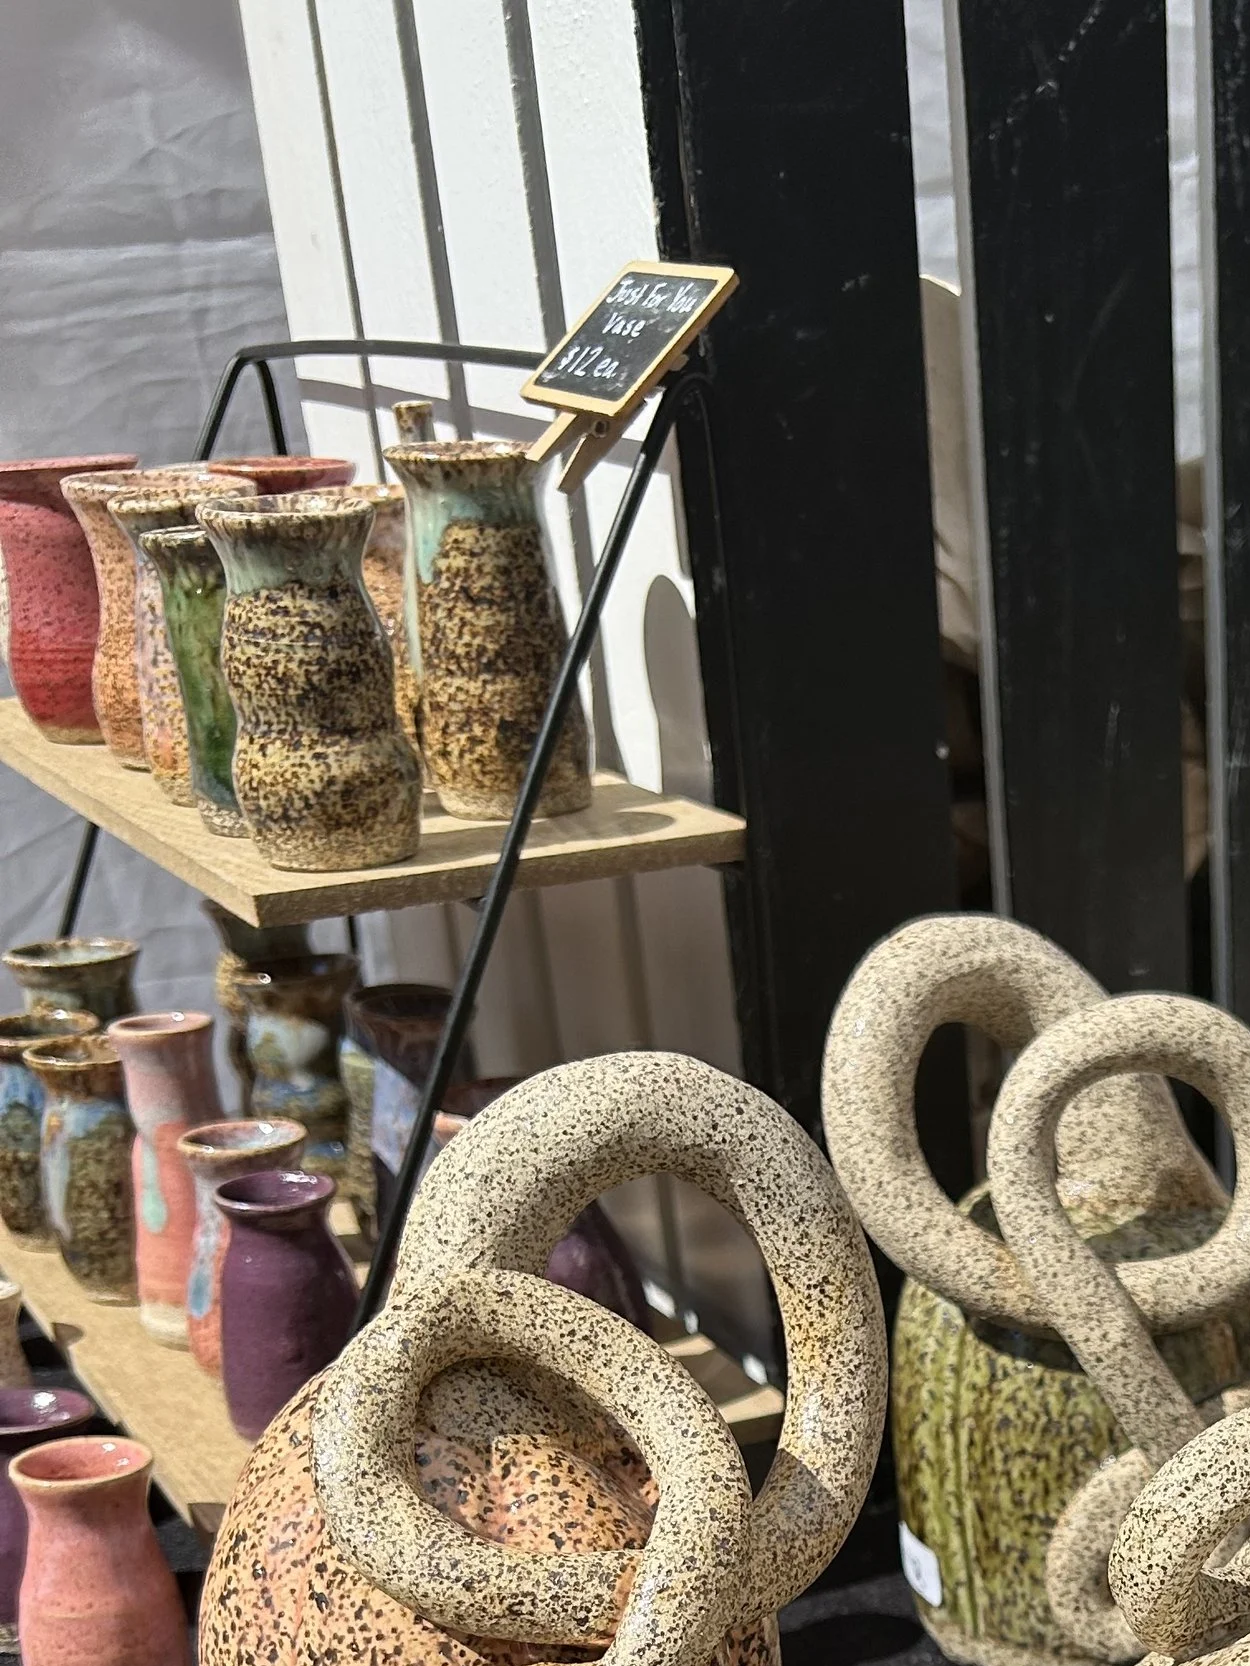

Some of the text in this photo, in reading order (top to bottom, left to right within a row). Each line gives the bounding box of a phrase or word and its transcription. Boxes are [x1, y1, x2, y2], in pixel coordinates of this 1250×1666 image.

[606, 279, 698, 313] Just For You
[602, 312, 646, 338] Vase
[558, 347, 604, 377] $12
